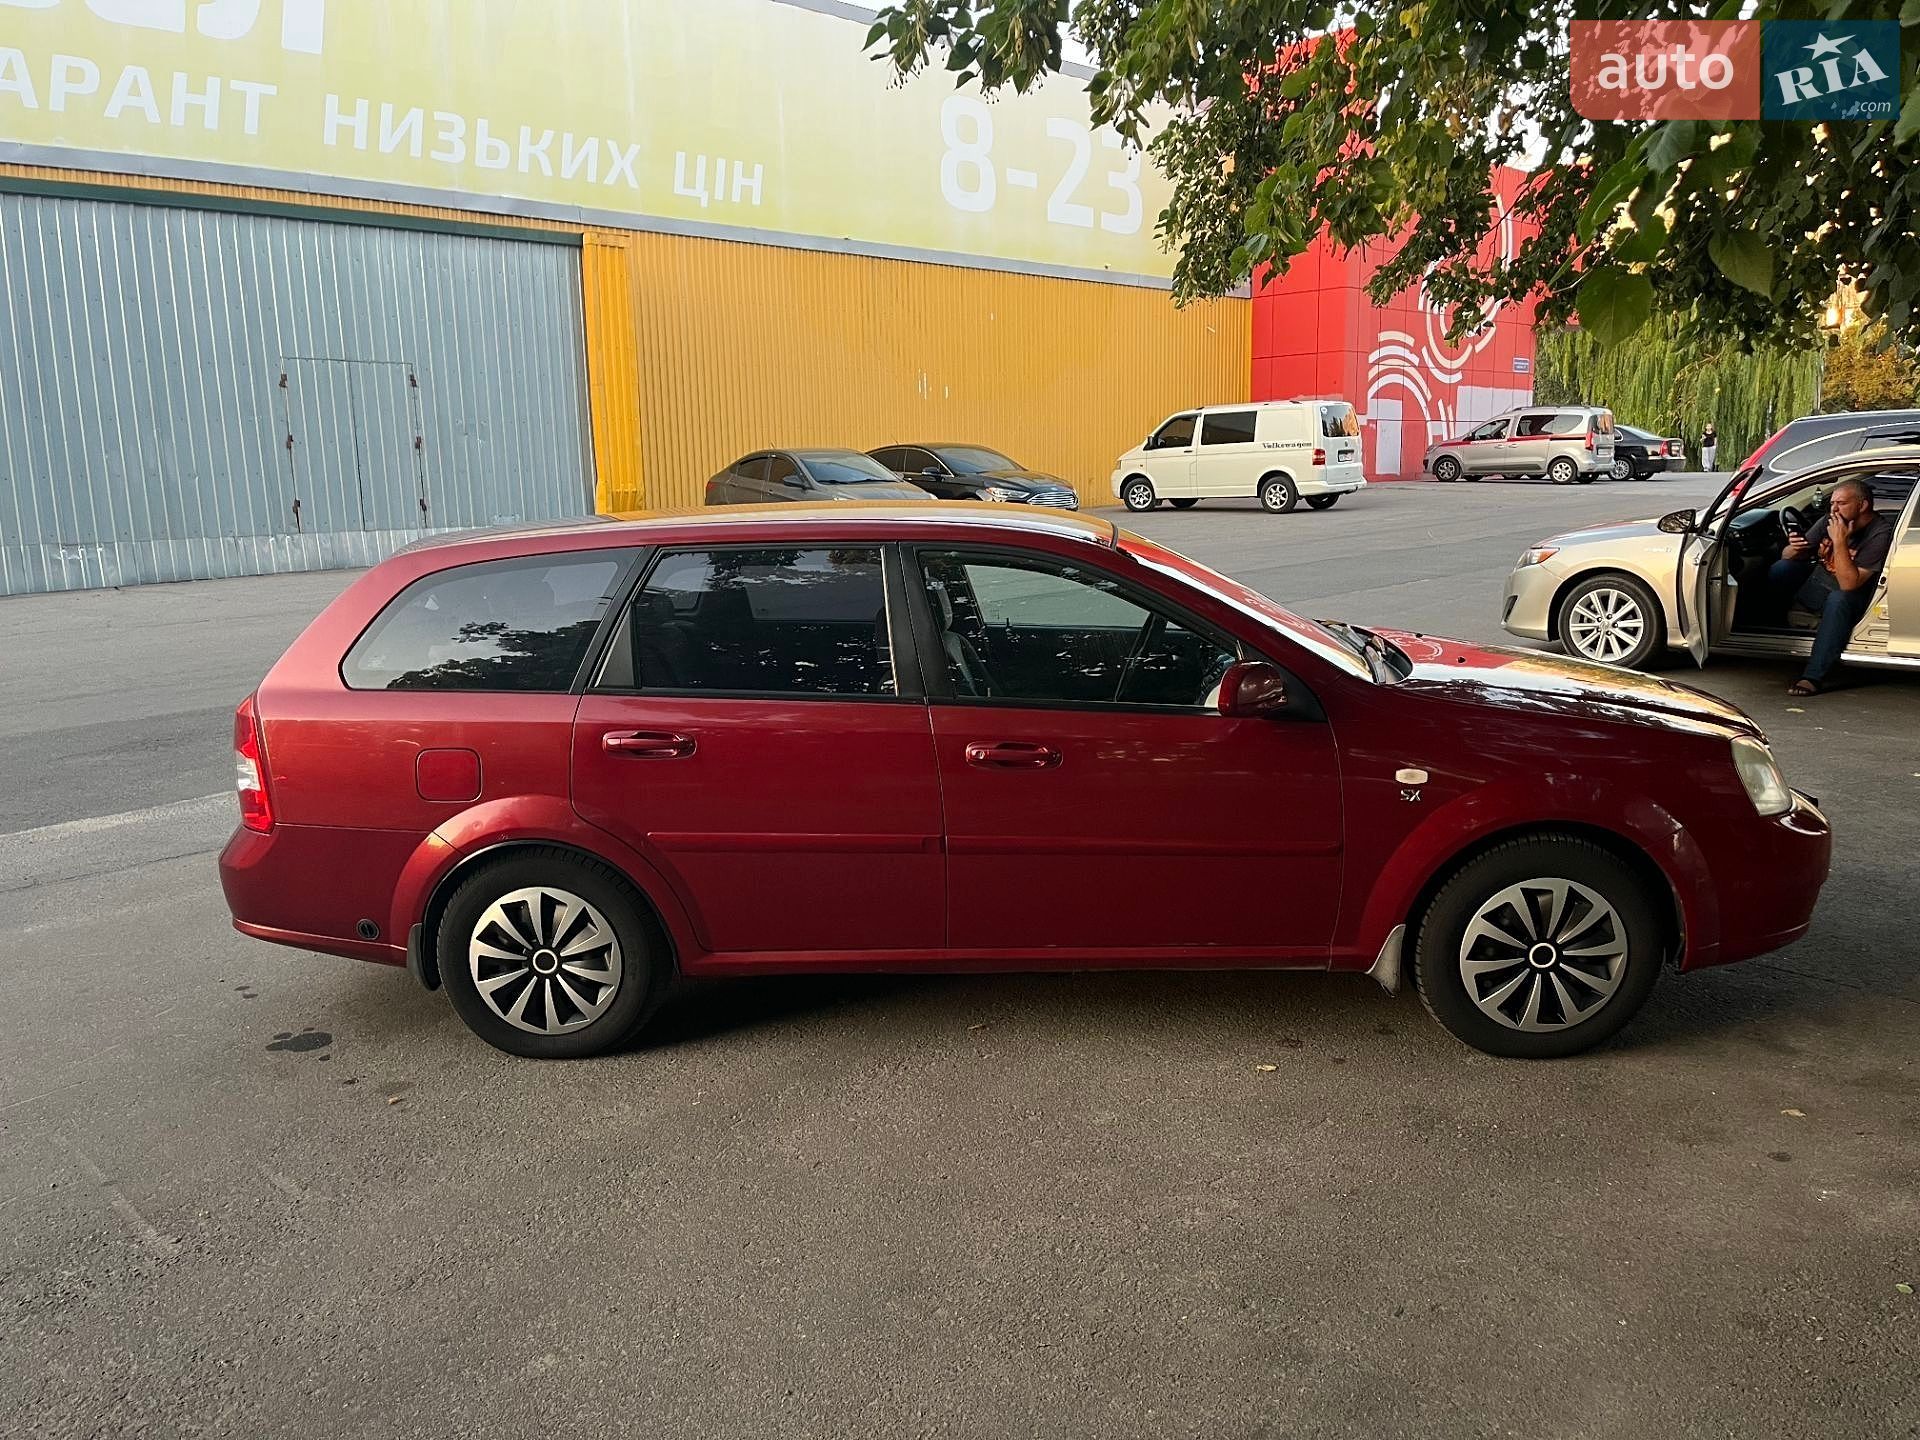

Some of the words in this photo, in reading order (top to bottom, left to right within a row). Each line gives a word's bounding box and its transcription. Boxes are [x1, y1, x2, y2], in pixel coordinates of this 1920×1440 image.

[323, 93, 642, 189] НИЗЬКИХ
[673, 151, 764, 208] ЦІН
[940, 94, 1144, 236] 8-23
[1400, 789, 1421, 802] SX
